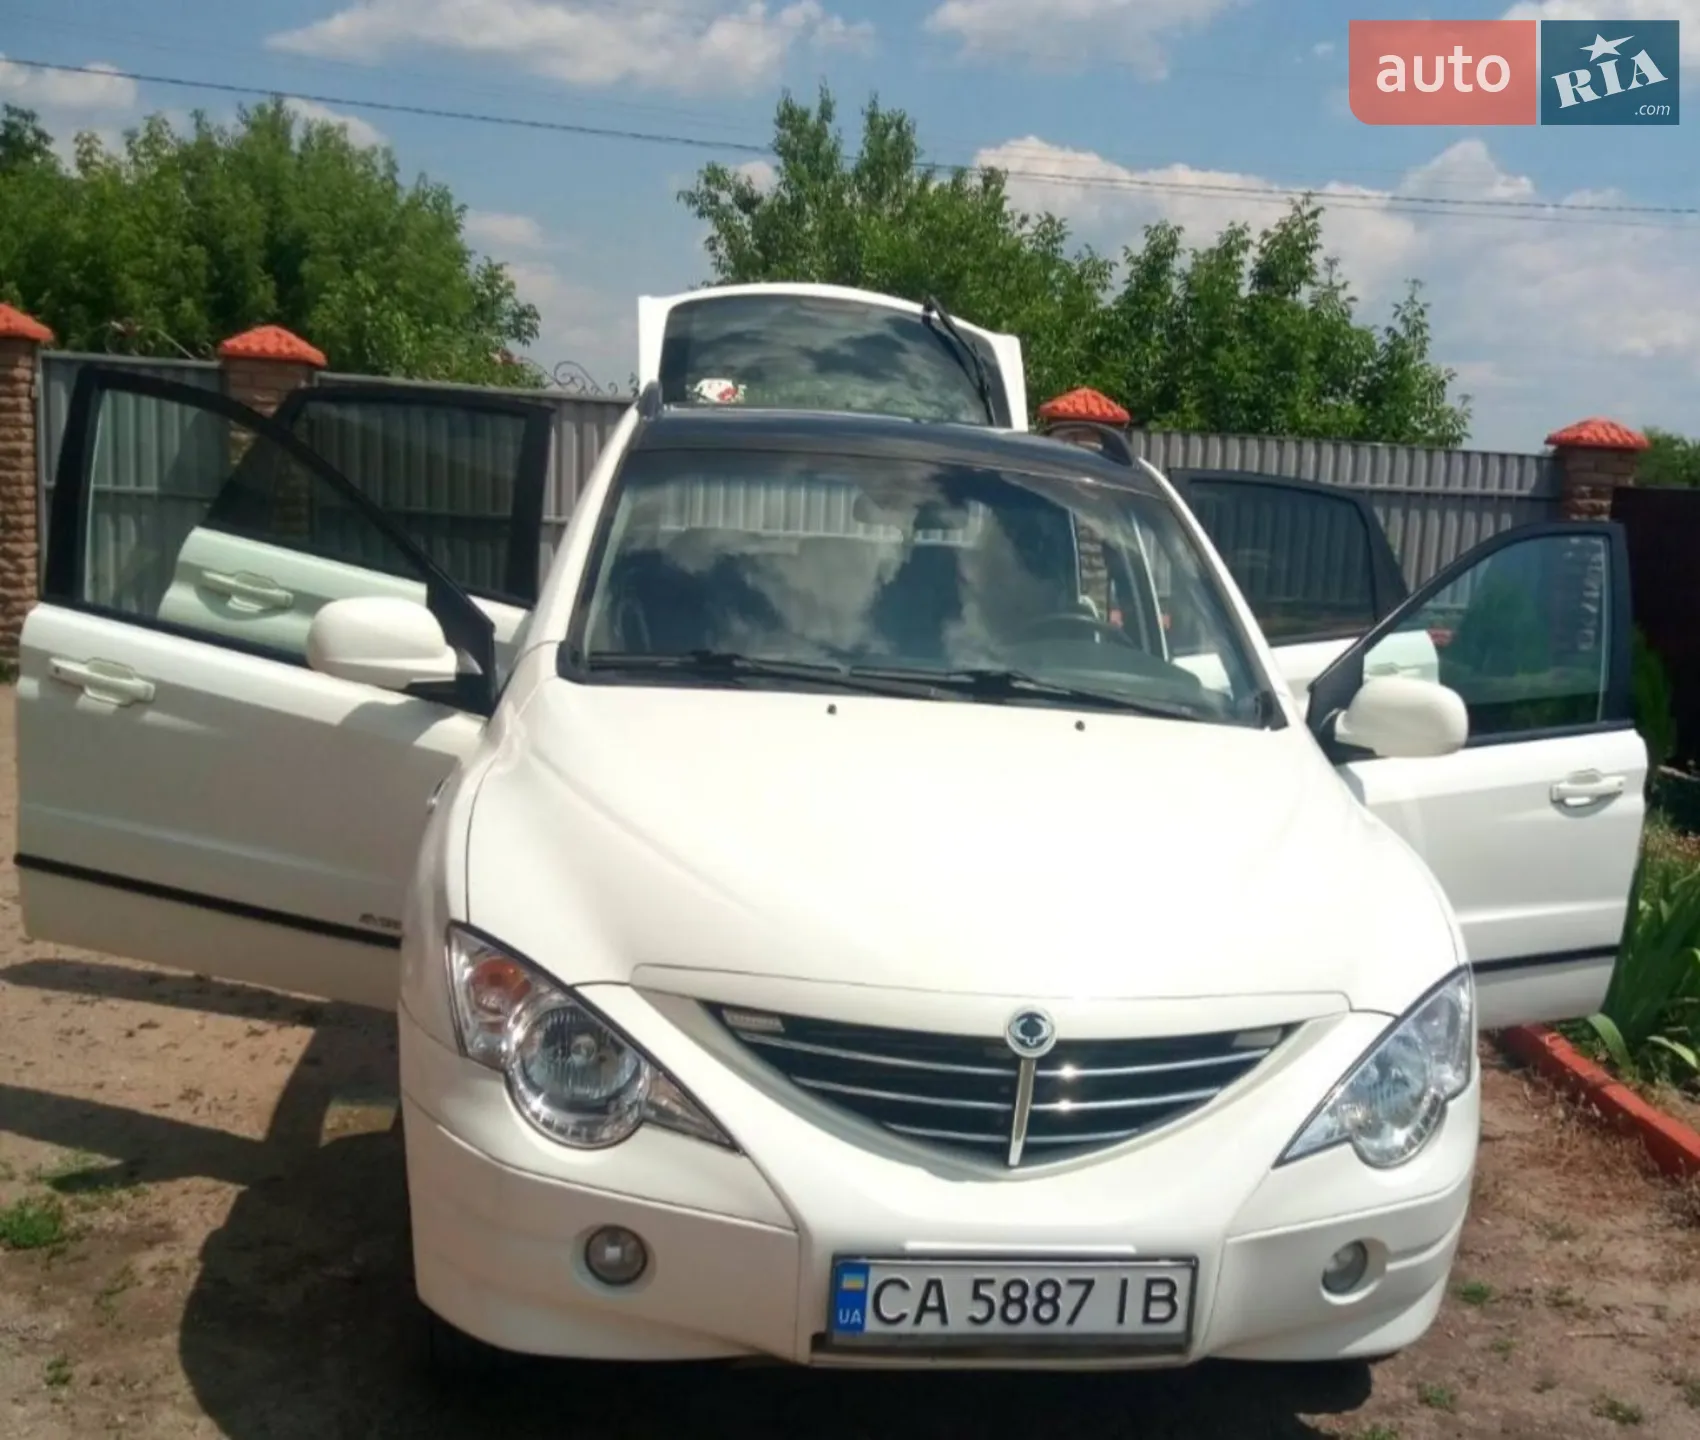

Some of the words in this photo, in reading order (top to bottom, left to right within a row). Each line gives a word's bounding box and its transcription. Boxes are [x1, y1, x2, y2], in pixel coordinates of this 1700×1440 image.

[872, 1277, 949, 1326] CA
[967, 1277, 1096, 1326] 5887
[1116, 1276, 1179, 1325] IB
[838, 1310, 862, 1325] UA
